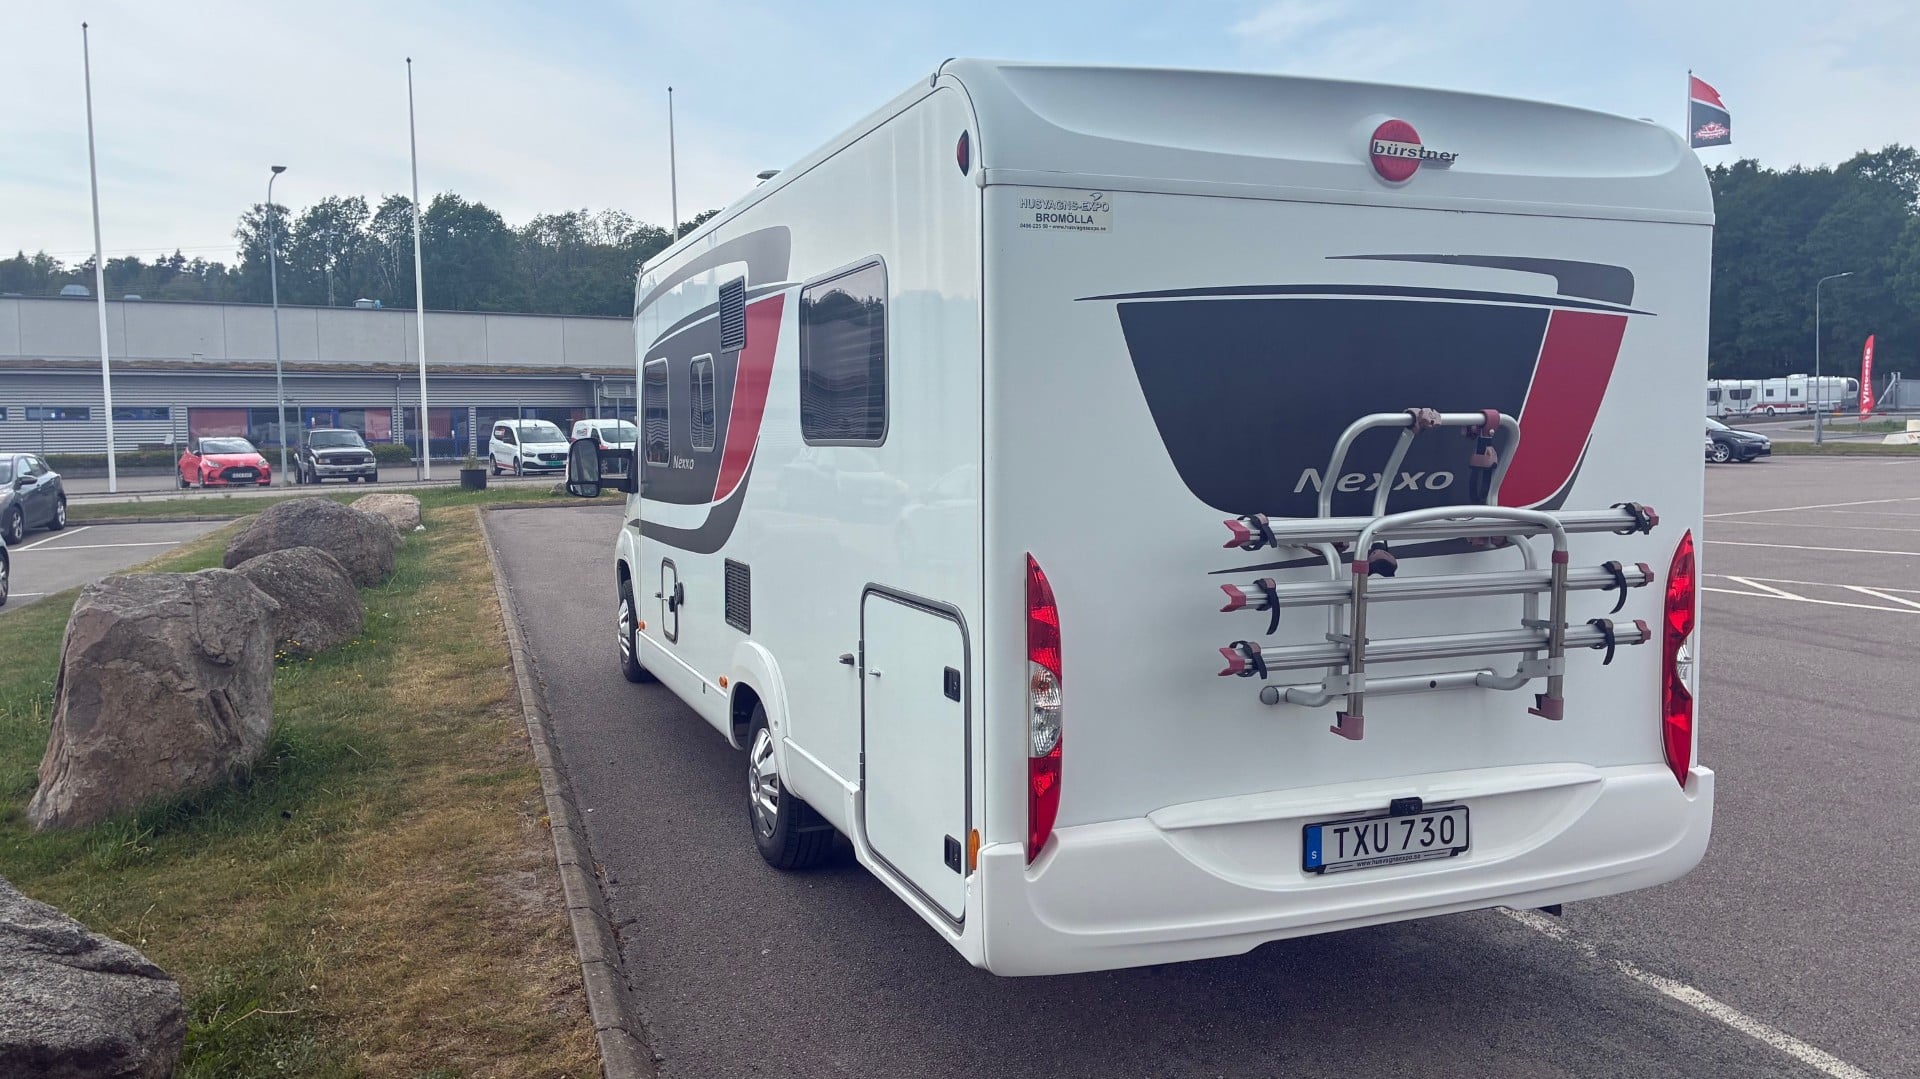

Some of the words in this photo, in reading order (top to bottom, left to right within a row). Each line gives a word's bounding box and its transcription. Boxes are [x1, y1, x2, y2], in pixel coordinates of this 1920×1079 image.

[1373, 141, 1459, 162] bürstner
[1020, 198, 1110, 212] HUSVAGNS-EXPO
[1035, 212, 1094, 224] BROMÖLLA
[673, 455, 694, 470] Nexxo
[1333, 822, 1389, 858] TXU
[1400, 815, 1455, 850] 730
[1311, 850, 1317, 860] S
